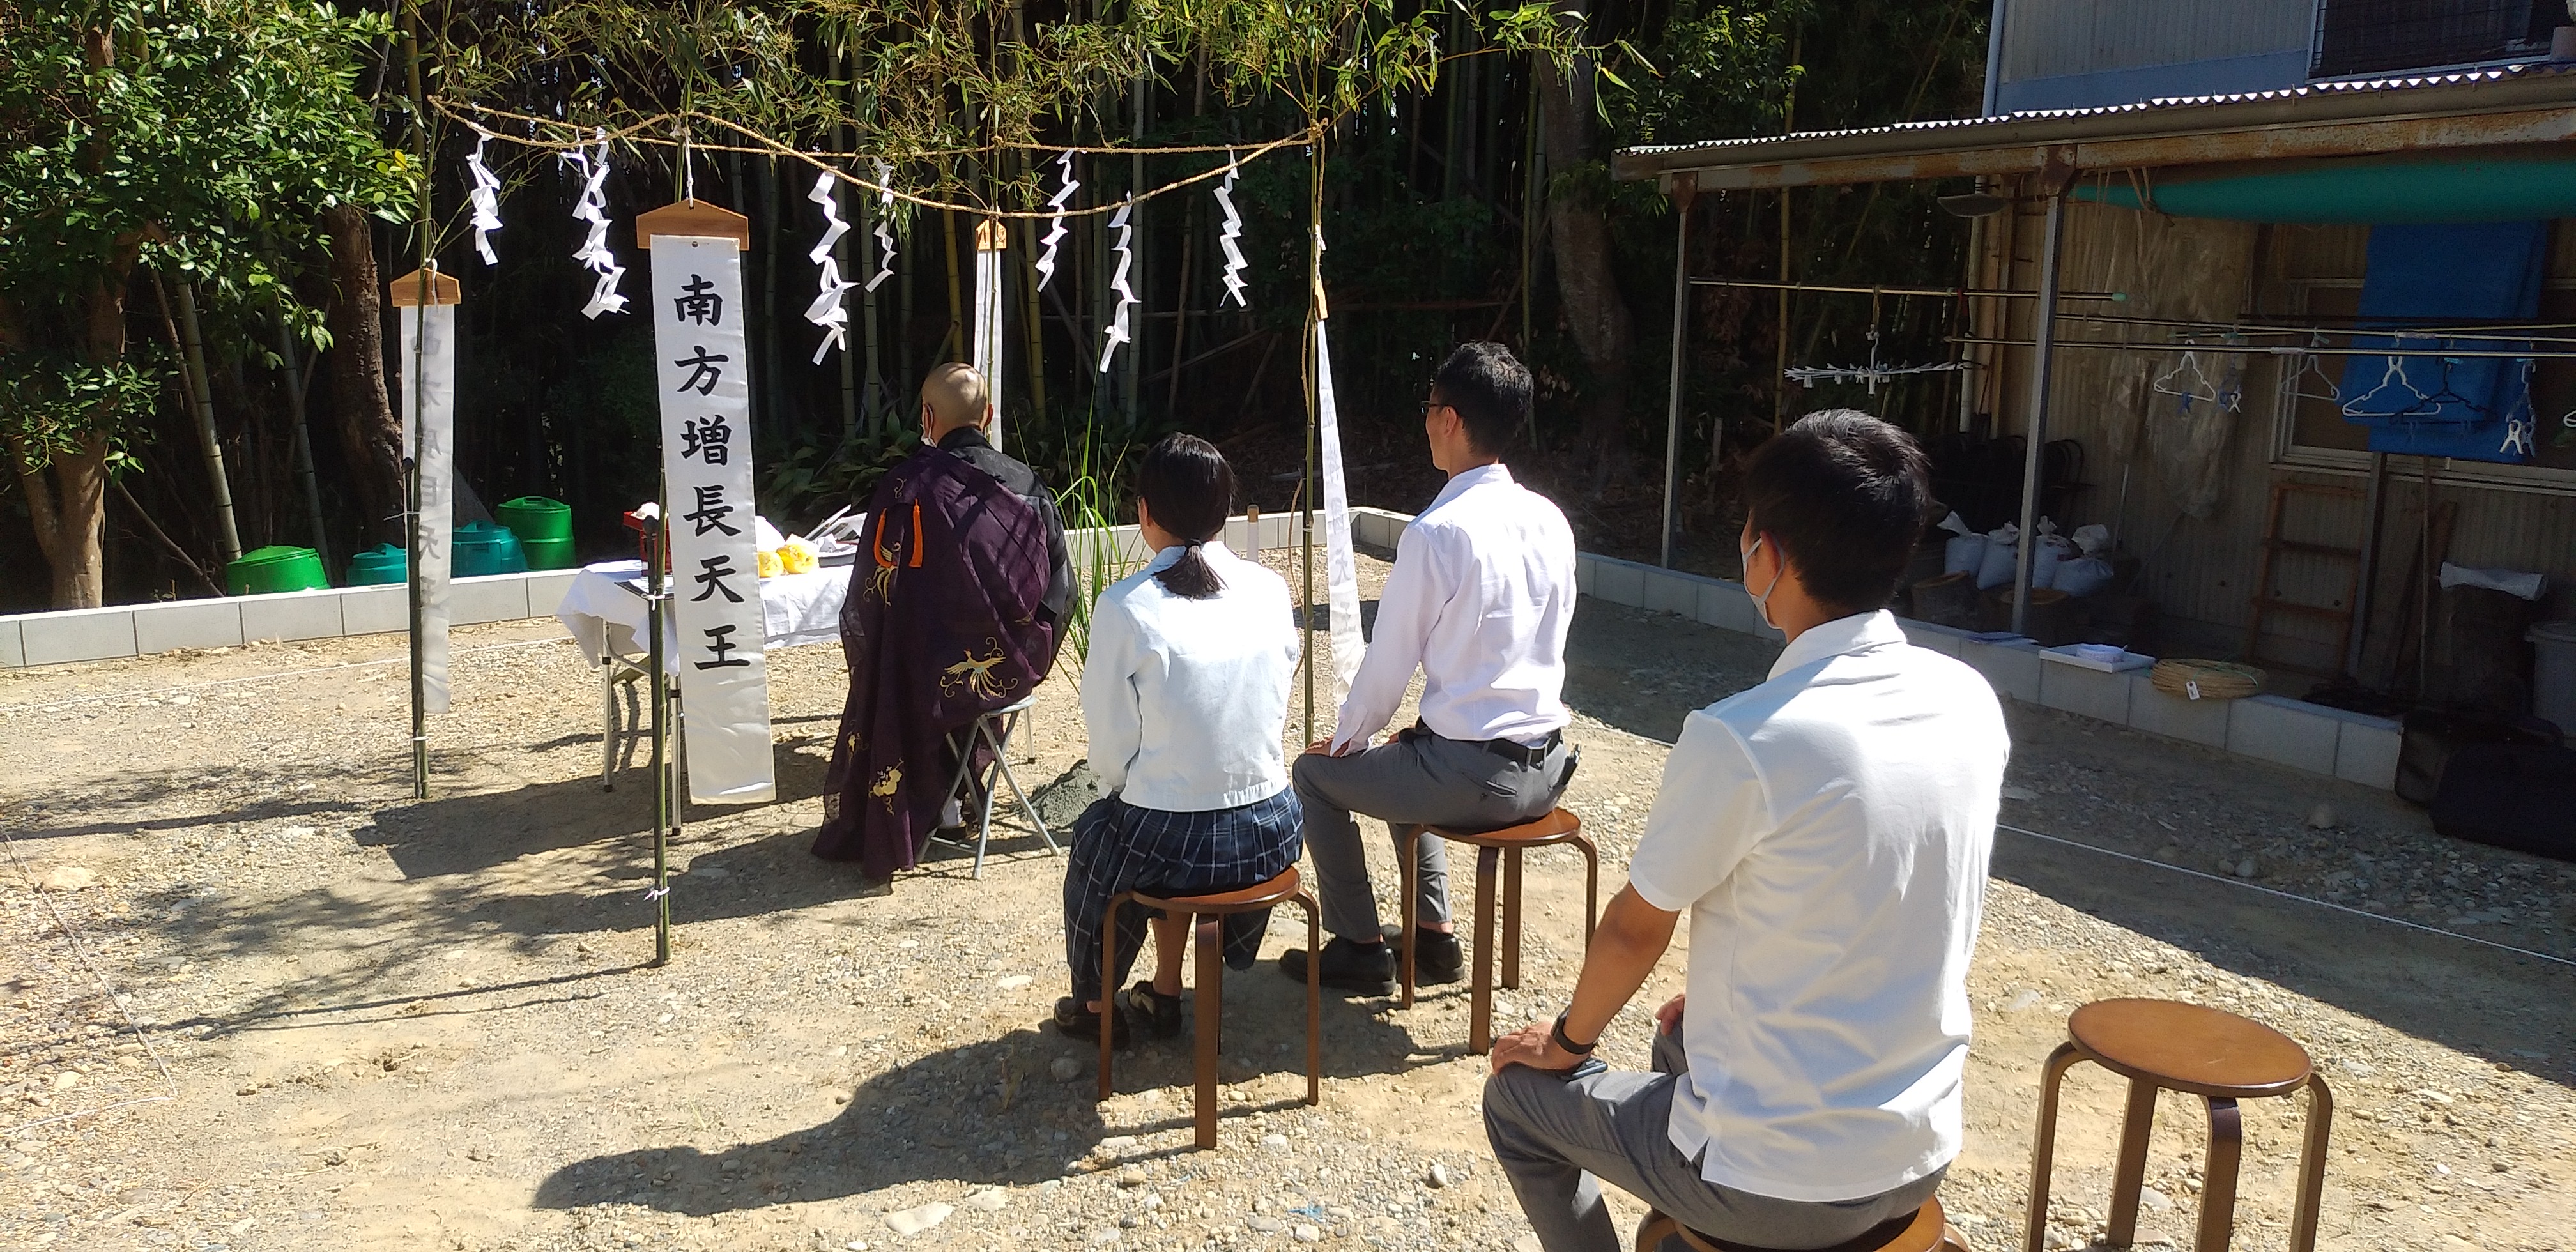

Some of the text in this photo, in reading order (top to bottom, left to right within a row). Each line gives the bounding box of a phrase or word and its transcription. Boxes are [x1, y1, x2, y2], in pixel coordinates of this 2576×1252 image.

[673, 273, 751, 672] 南方増長天王
